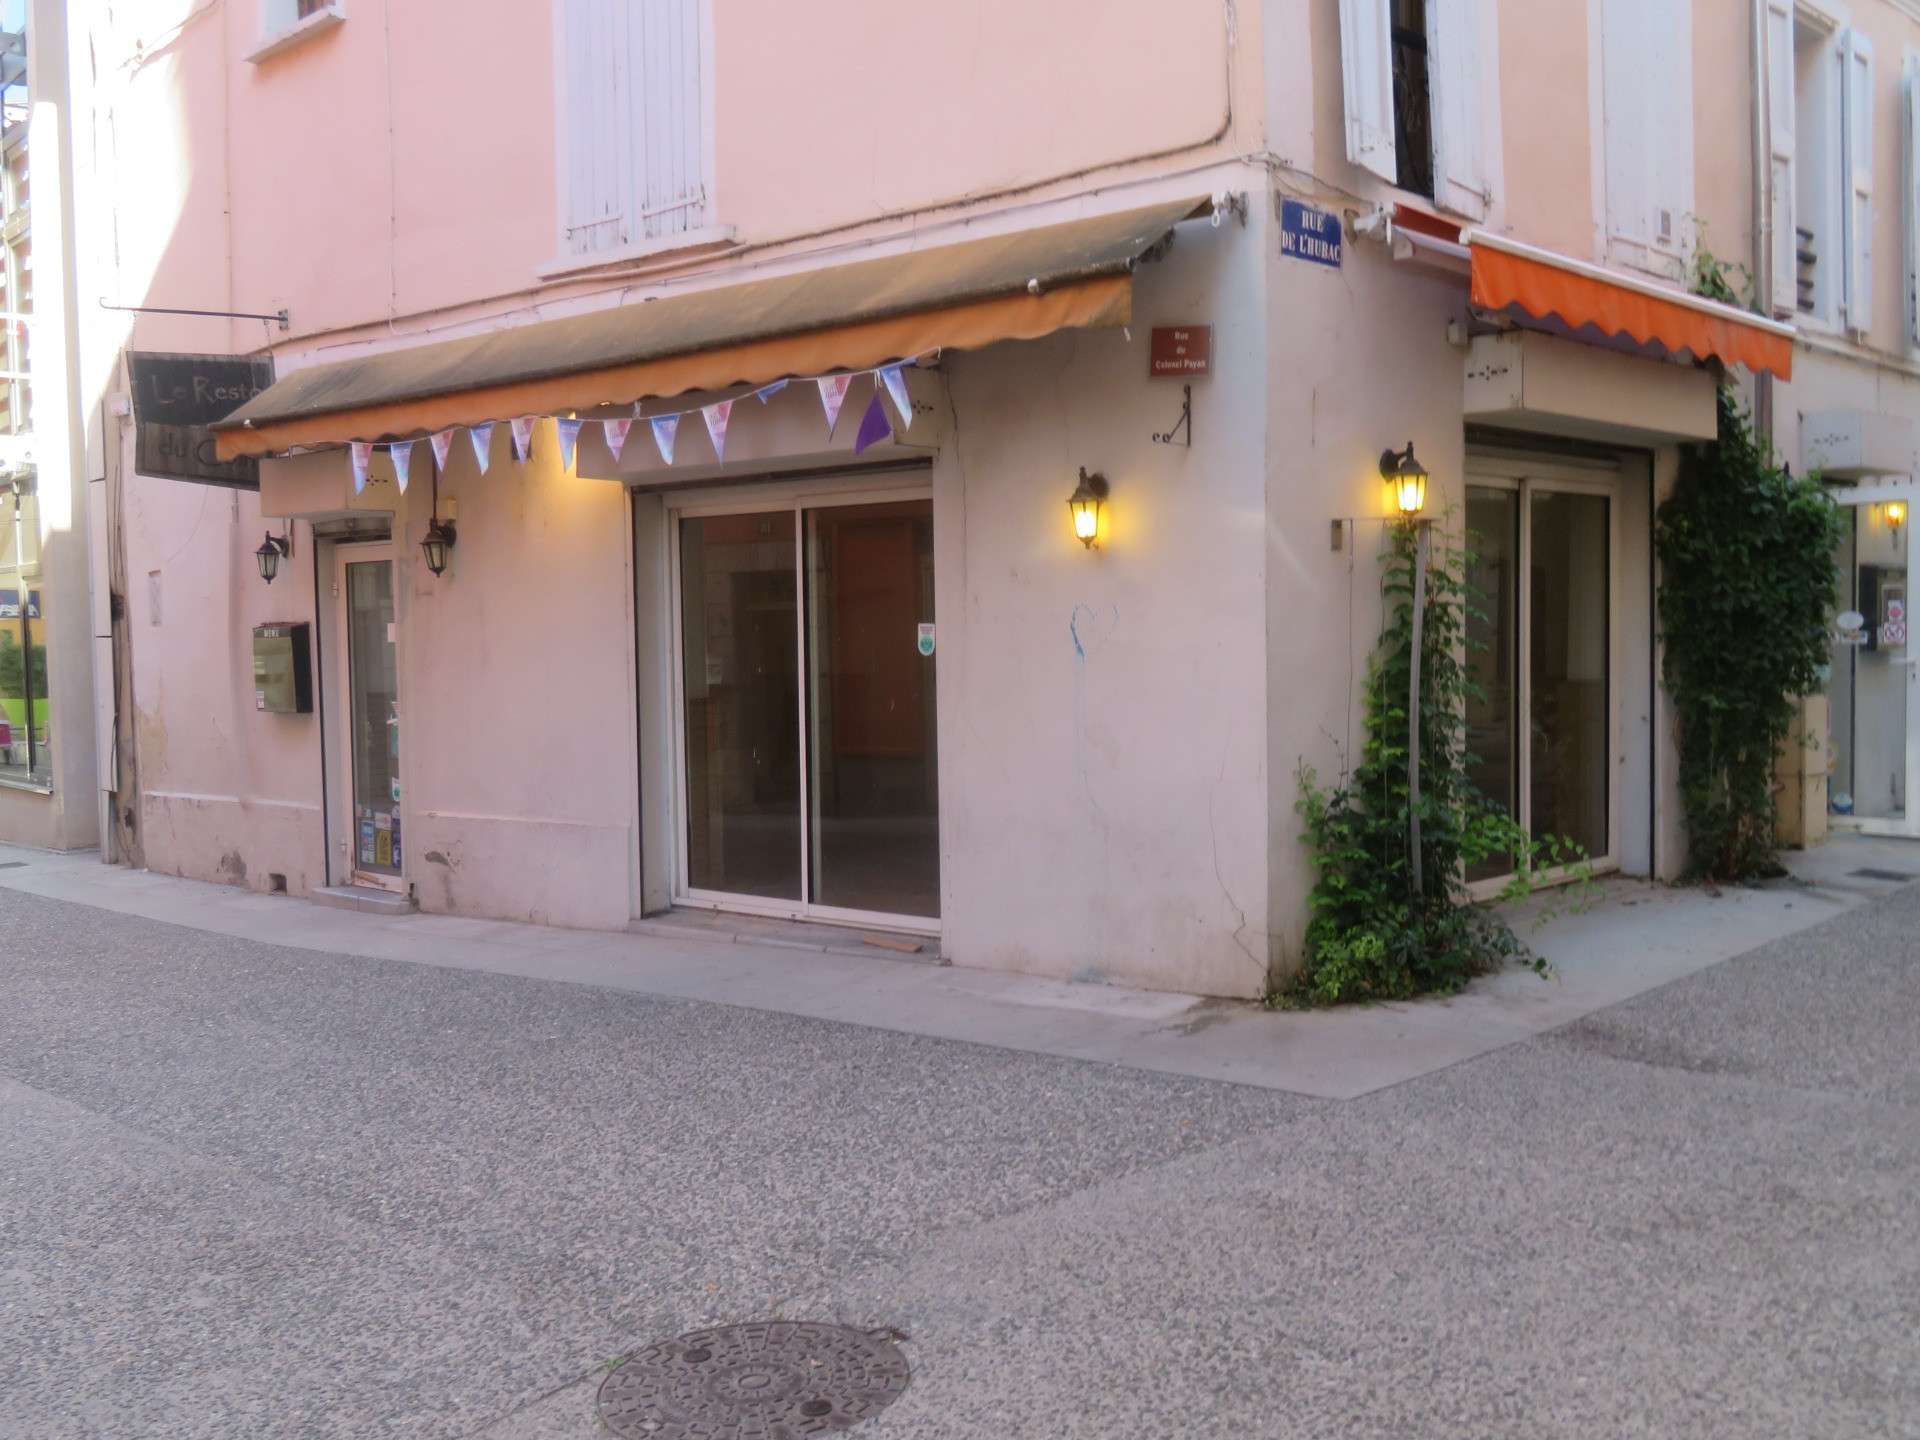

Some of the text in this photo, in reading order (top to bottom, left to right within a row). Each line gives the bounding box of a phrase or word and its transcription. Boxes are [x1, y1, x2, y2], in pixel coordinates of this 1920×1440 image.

[1302, 209, 1325, 233] RUE
[1282, 231, 1296, 251] DE
[152, 374, 187, 404] Le
